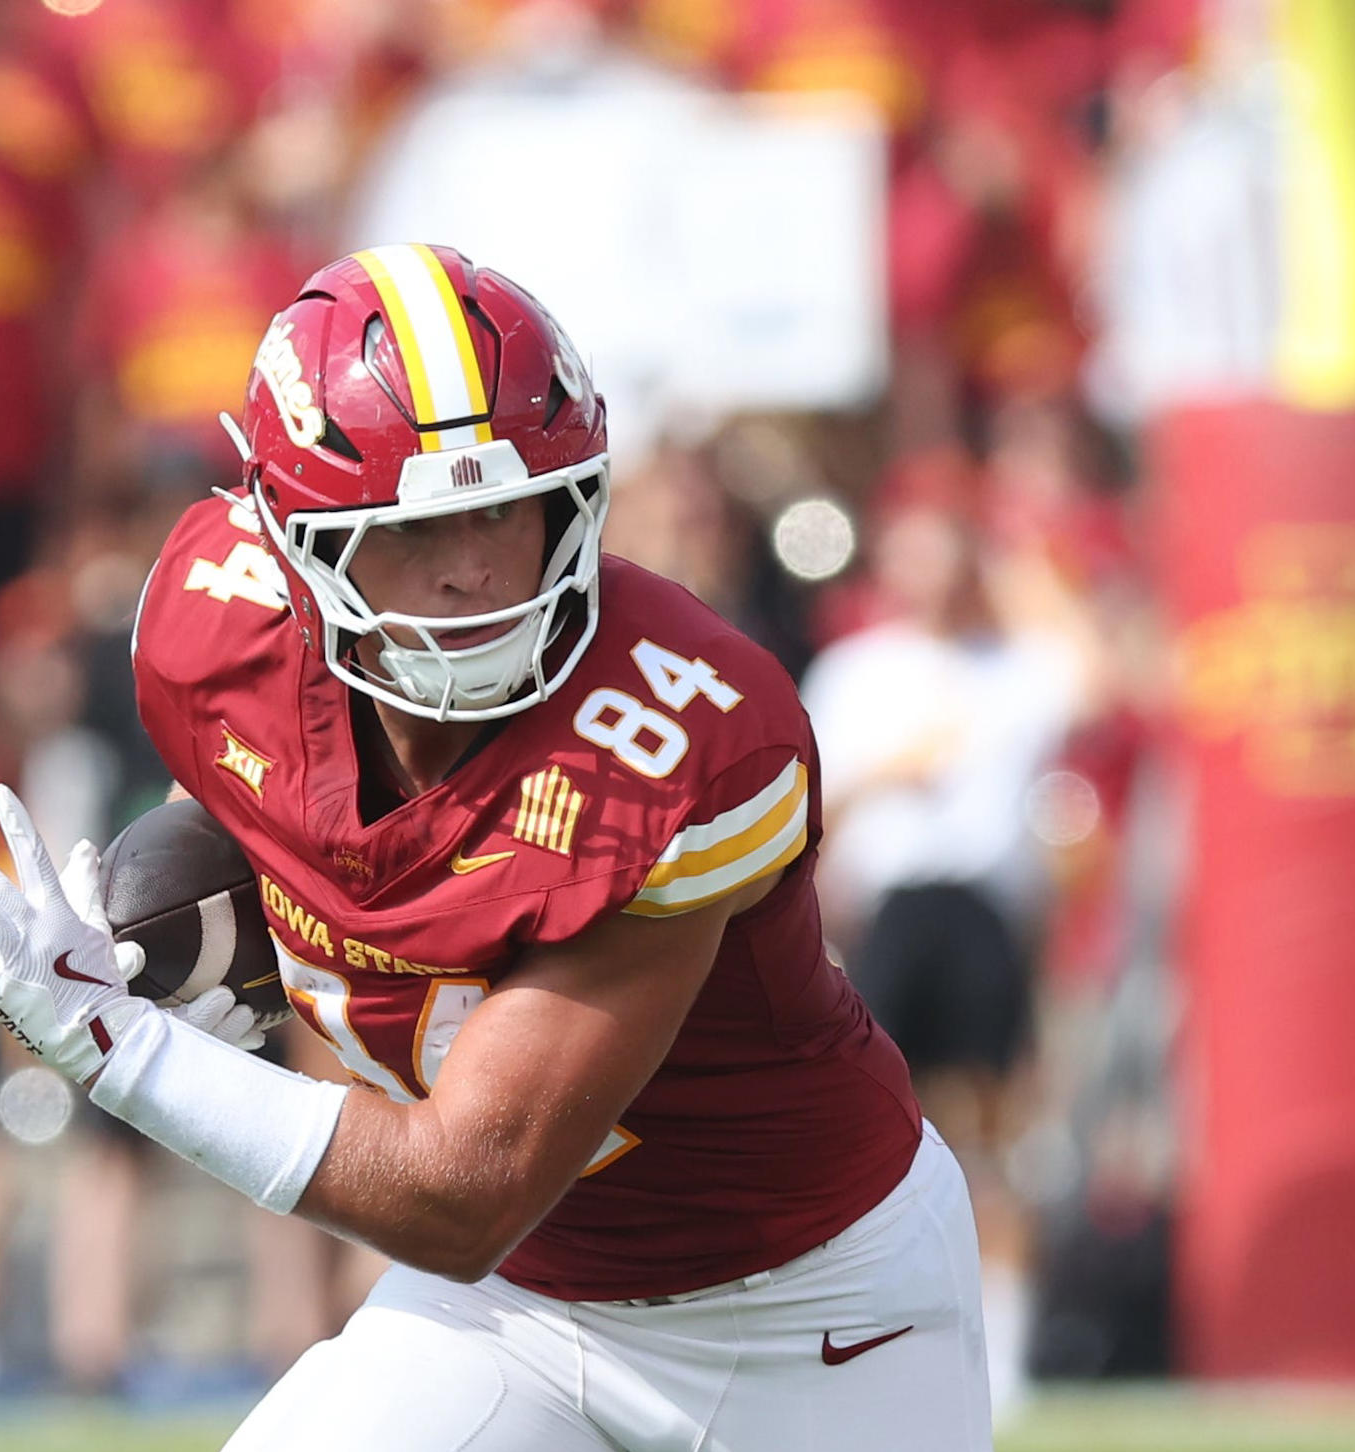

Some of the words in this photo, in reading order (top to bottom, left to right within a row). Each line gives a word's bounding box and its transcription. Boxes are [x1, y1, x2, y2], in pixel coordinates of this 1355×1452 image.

[573, 638, 744, 779] 84
[260, 873, 334, 958] IOWA
[342, 937, 470, 976] STA
